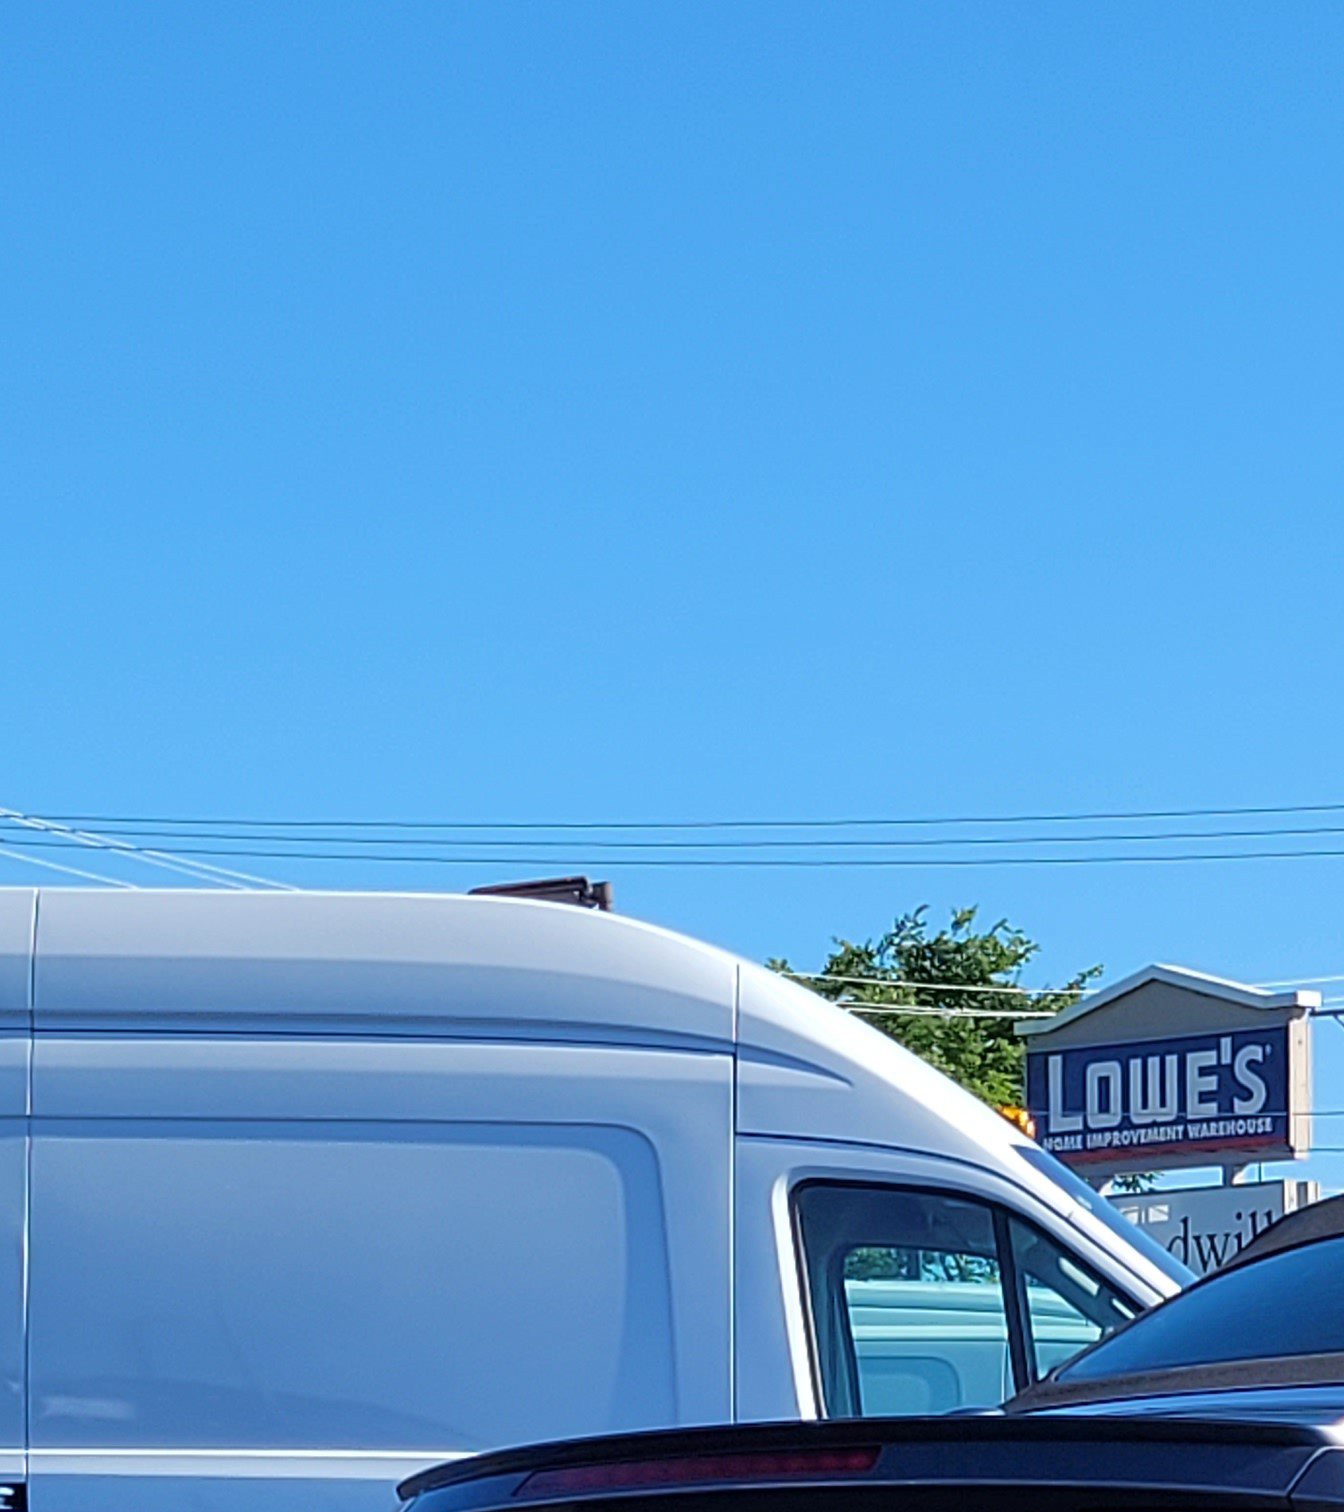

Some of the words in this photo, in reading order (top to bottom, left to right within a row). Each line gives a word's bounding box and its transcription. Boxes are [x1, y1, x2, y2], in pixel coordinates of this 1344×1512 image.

[1048, 1036, 1268, 1133] LOWE'S
[1043, 1134, 1082, 1151] HOME
[1086, 1126, 1183, 1149] IMPROVEMENT
[1188, 1117, 1273, 1138] WAREHOUSE
